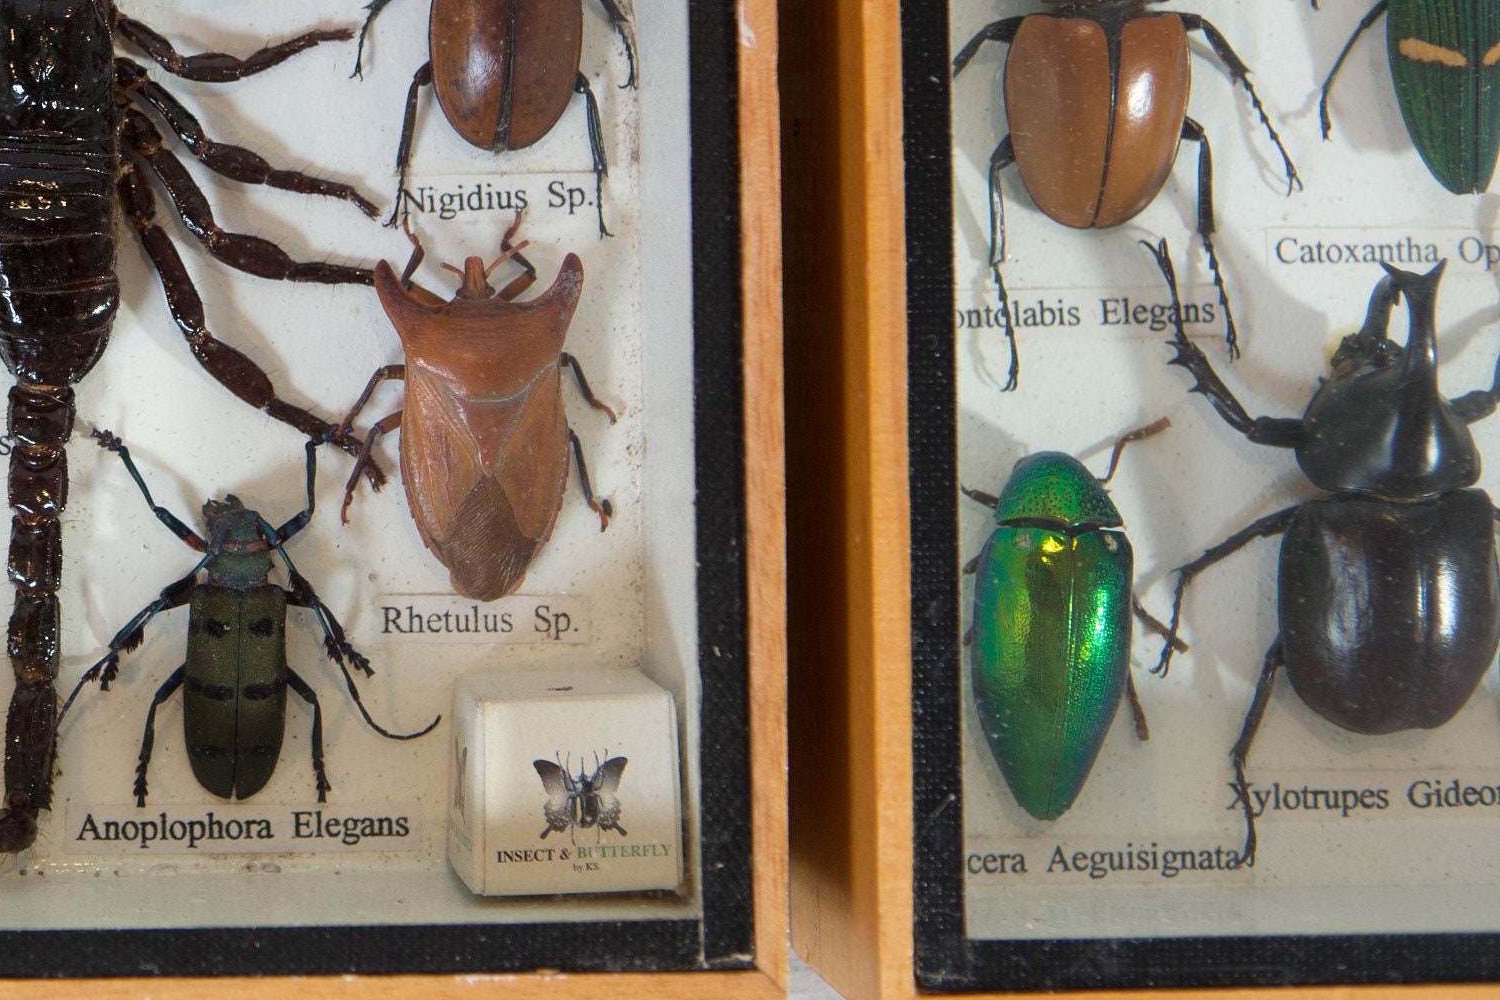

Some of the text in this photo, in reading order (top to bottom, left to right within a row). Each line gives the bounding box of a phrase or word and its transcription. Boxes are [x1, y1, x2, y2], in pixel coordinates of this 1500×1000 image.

[401, 180, 594, 220] Nigidius Sp.
[1275, 236, 1440, 265] Catoxantha
[1099, 298, 1216, 332] Elegans
[380, 605, 579, 641] Rhetulus Sp.
[1226, 782, 1390, 818] Xylotrupes
[76, 812, 275, 849] Anoplophora
[292, 810, 411, 846] Elegans
[497, 844, 672, 864] INSECT & BUTTERFLY
[573, 863, 584, 874] by
[1047, 842, 1241, 879] Aeguisignata
